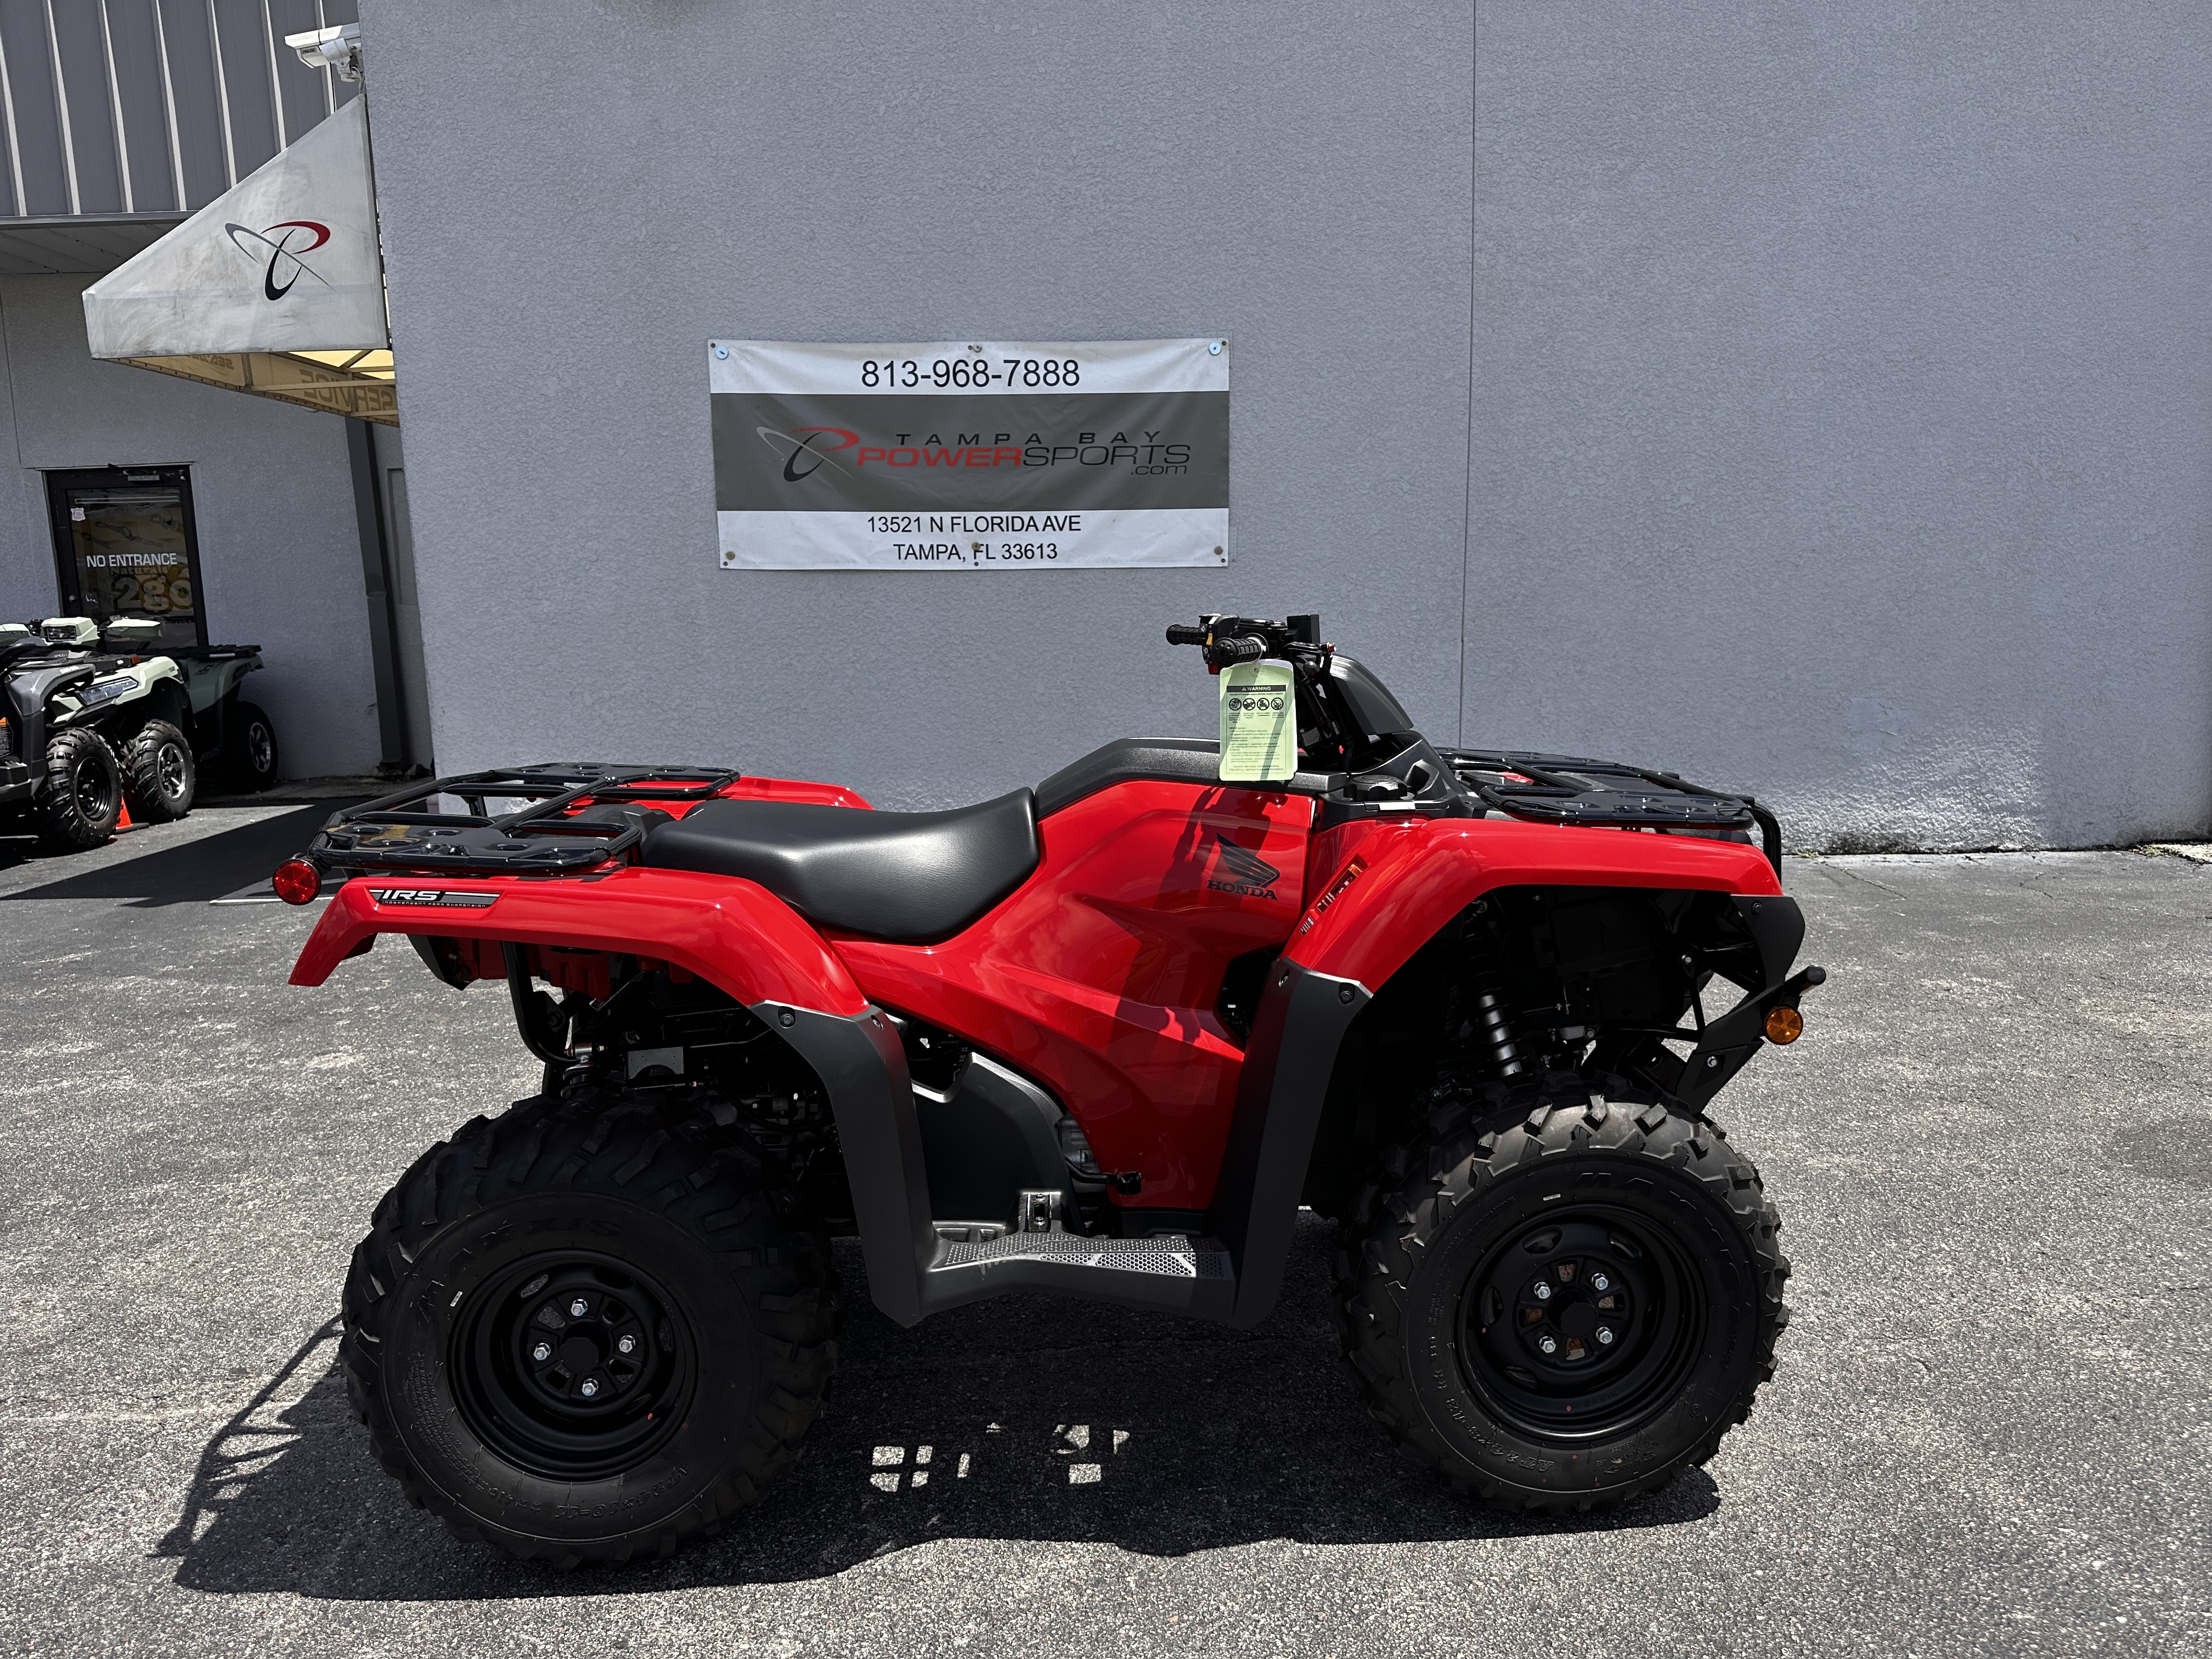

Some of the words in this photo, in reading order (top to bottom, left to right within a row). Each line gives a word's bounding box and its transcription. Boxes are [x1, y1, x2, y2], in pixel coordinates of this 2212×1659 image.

[862, 359, 1080, 388] 813-968-7888
[896, 433, 1042, 445] TAMPA
[1079, 431, 1160, 444] BAY
[856, 444, 1190, 467] POWERSPORTS
[1131, 465, 1187, 475] .com
[867, 516, 921, 533] 13521
[930, 516, 943, 533] N
[951, 515, 1039, 533] FLORIDA
[1042, 515, 1081, 532] AVE
[86, 555, 106, 568] NO
[109, 552, 178, 567] ENTRANCE
[893, 544, 966, 563] TAMPA,
[973, 544, 996, 560] FL
[1001, 543, 1058, 560] 33613
[382, 889, 441, 901] IRS
[1207, 879, 1278, 901] HONDA
